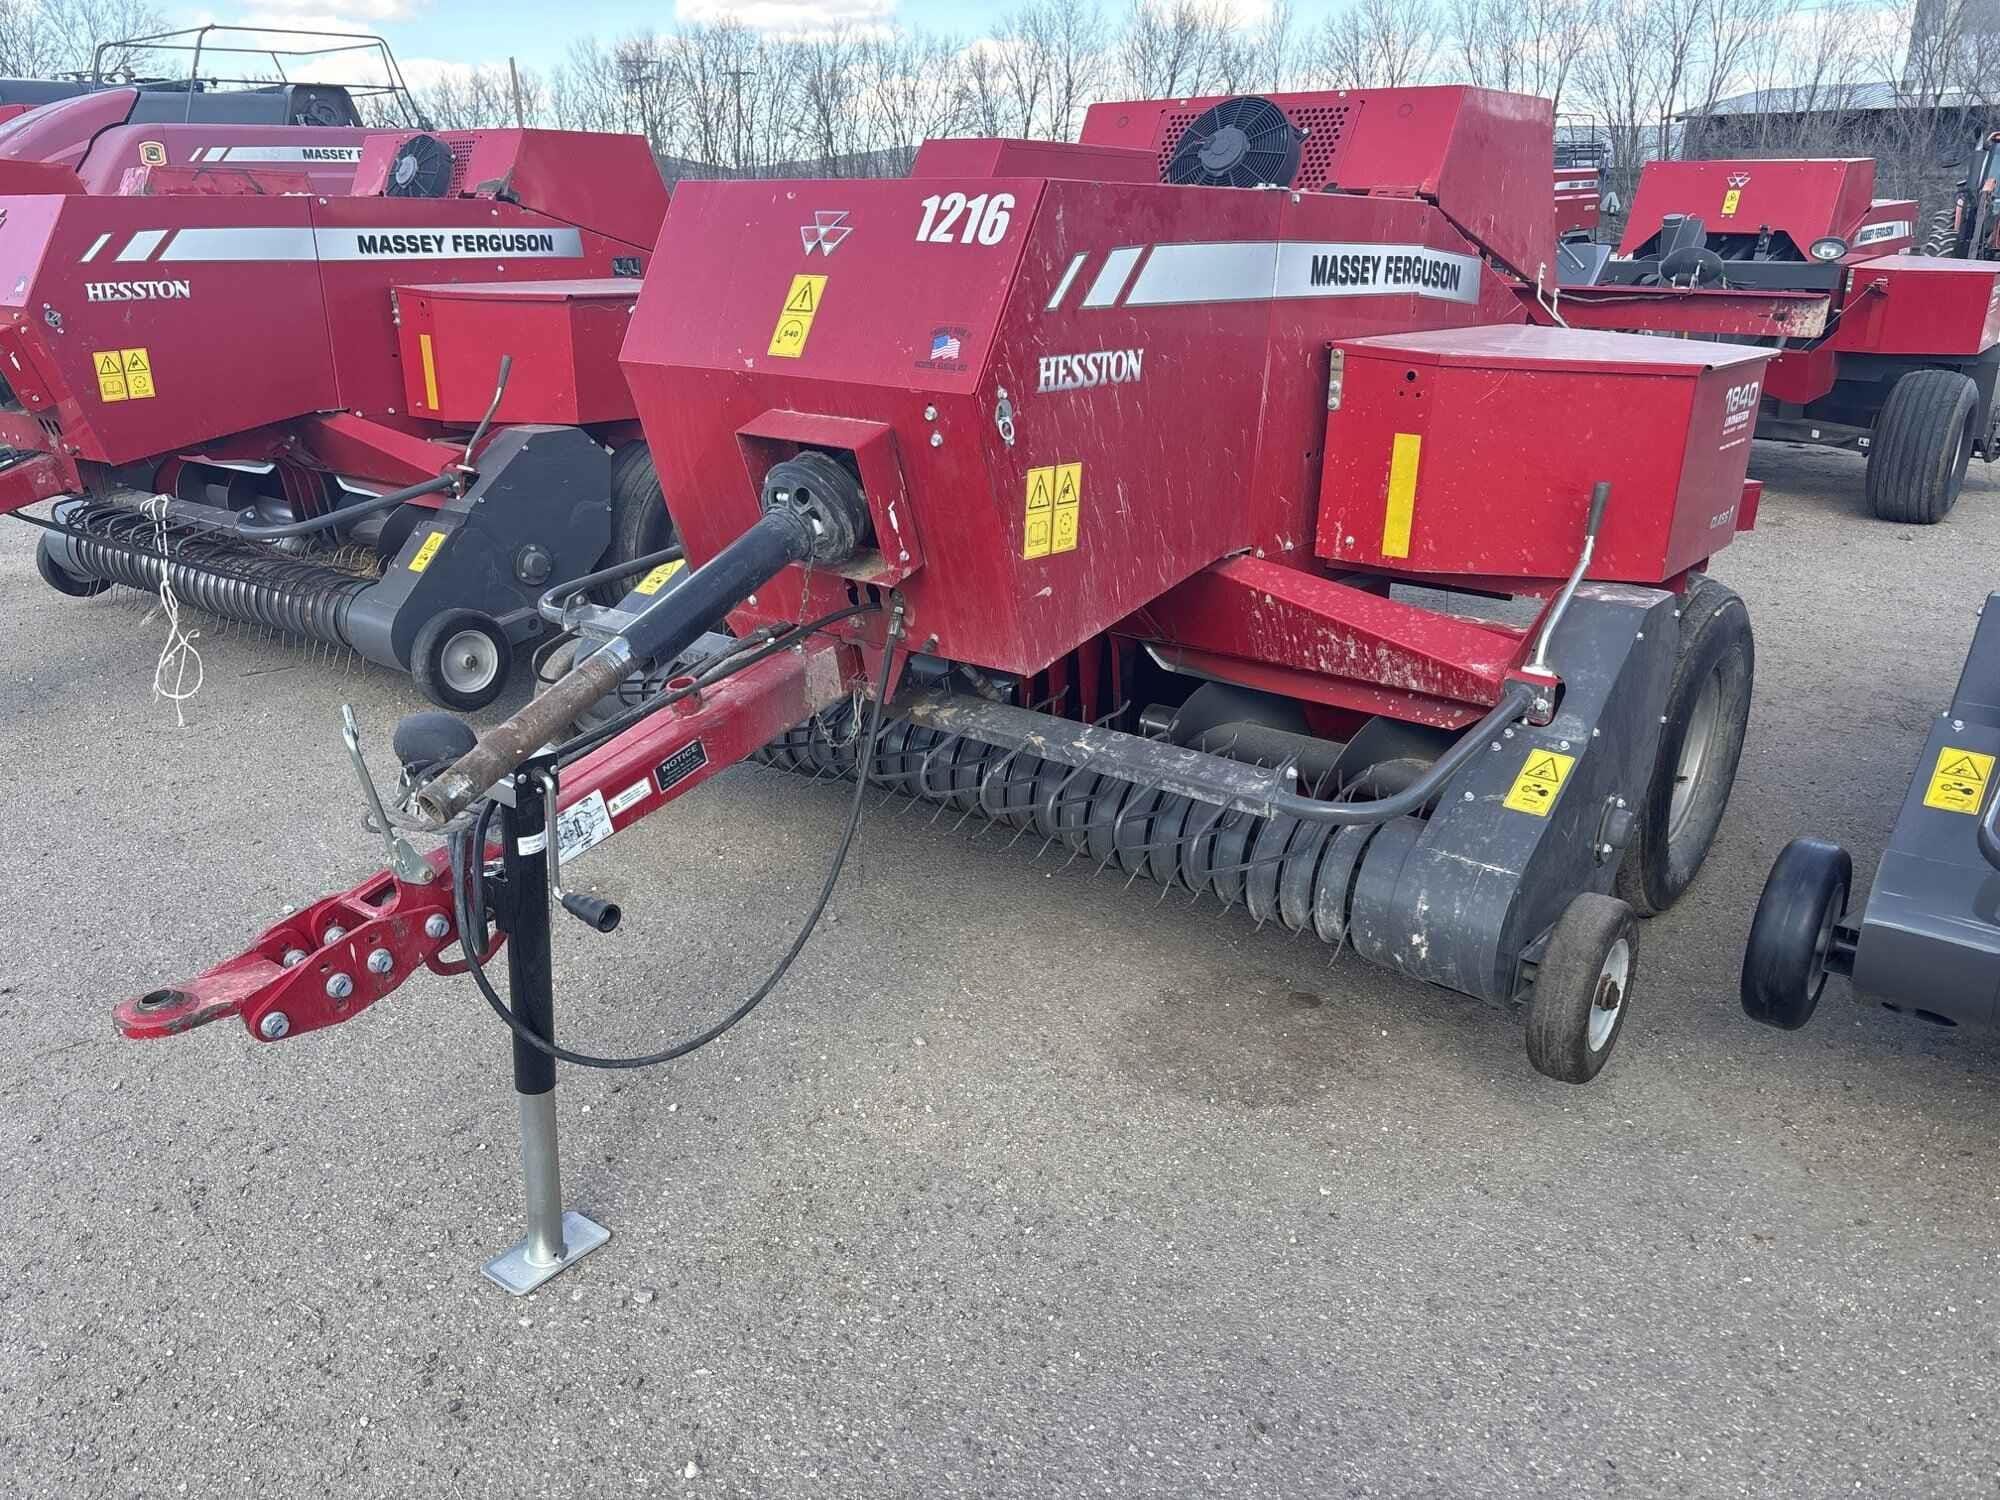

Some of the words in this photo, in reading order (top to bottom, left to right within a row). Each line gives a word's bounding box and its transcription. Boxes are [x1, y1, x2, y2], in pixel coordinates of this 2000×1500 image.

[302, 148, 353, 160] MASSEY
[915, 192, 1016, 246] 1216
[357, 235, 444, 254] MASSEY
[452, 234, 554, 253] FERGUSON
[1310, 254, 1381, 286] MASSEY
[1384, 255, 1461, 291] FERGUSON
[85, 280, 191, 302] HESSTON
[783, 330, 799, 338] 540
[1036, 348, 1144, 393] HESSTON
[1725, 381, 1759, 414] 1840
[662, 744, 698, 772] NOTICE
